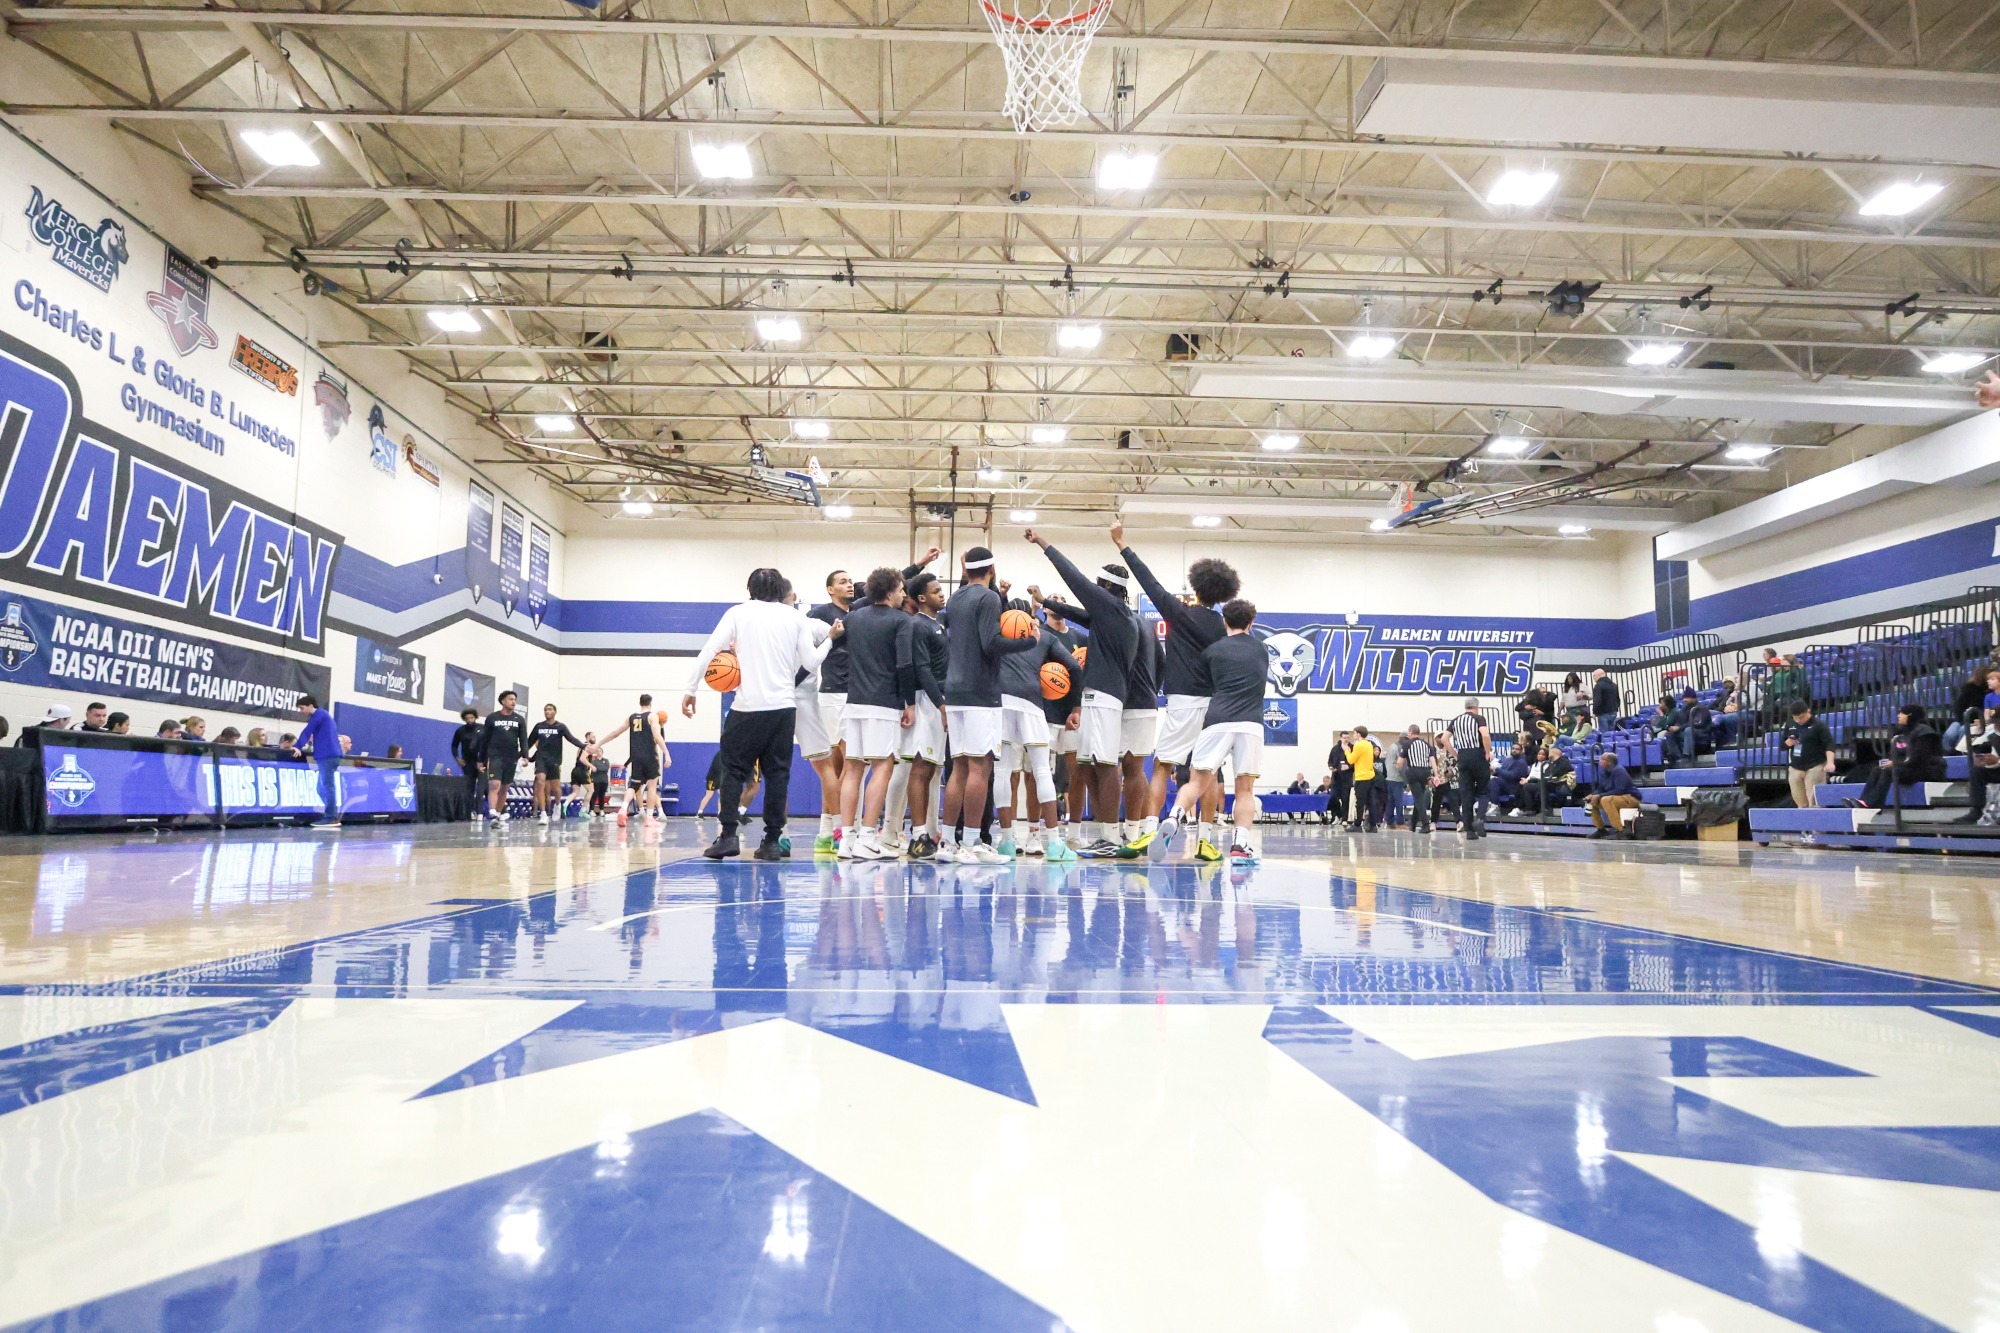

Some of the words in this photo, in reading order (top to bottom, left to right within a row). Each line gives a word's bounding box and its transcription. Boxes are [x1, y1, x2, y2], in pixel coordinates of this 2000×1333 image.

[28, 194, 100, 249] MERCY
[32, 214, 114, 278] COLLEGE
[56, 247, 110, 290] Mavericks
[169, 256, 186, 271] EAST
[186, 267, 205, 285] COAST
[169, 267, 205, 296] CONFERENCE
[14, 278, 103, 351] Charles
[132, 345, 146, 375] &
[154, 359, 205, 408] Gloria
[210, 389, 225, 419] B.
[229, 401, 296, 458] Lumsden
[121, 382, 225, 456] Gymnasium
[373, 433, 398, 473] CSI
[415, 452, 440, 476] SPARTAN
[0, 349, 337, 644] DAEMEN
[51, 615, 114, 653] NCAA
[118, 629, 155, 661] DII
[157, 638, 215, 672] MEN'S
[1157, 620, 1167, 636] 0
[1381, 628, 1442, 642] DAEMEN
[1446, 629, 1534, 643] UNIVERSITY
[49, 647, 183, 694] BASKETBALL
[382, 654, 399, 666] DIVISION
[704, 668, 718, 678] CAA
[1308, 628, 1534, 694] WILDCATS
[366, 671, 382, 685] MAKE
[382, 675, 388, 685] IT
[387, 670, 407, 692] YOURS
[1045, 676, 1066, 690] NCAA
[633, 718, 643, 733] 21
[203, 763, 256, 807] THIS
[257, 767, 279, 807] IS
